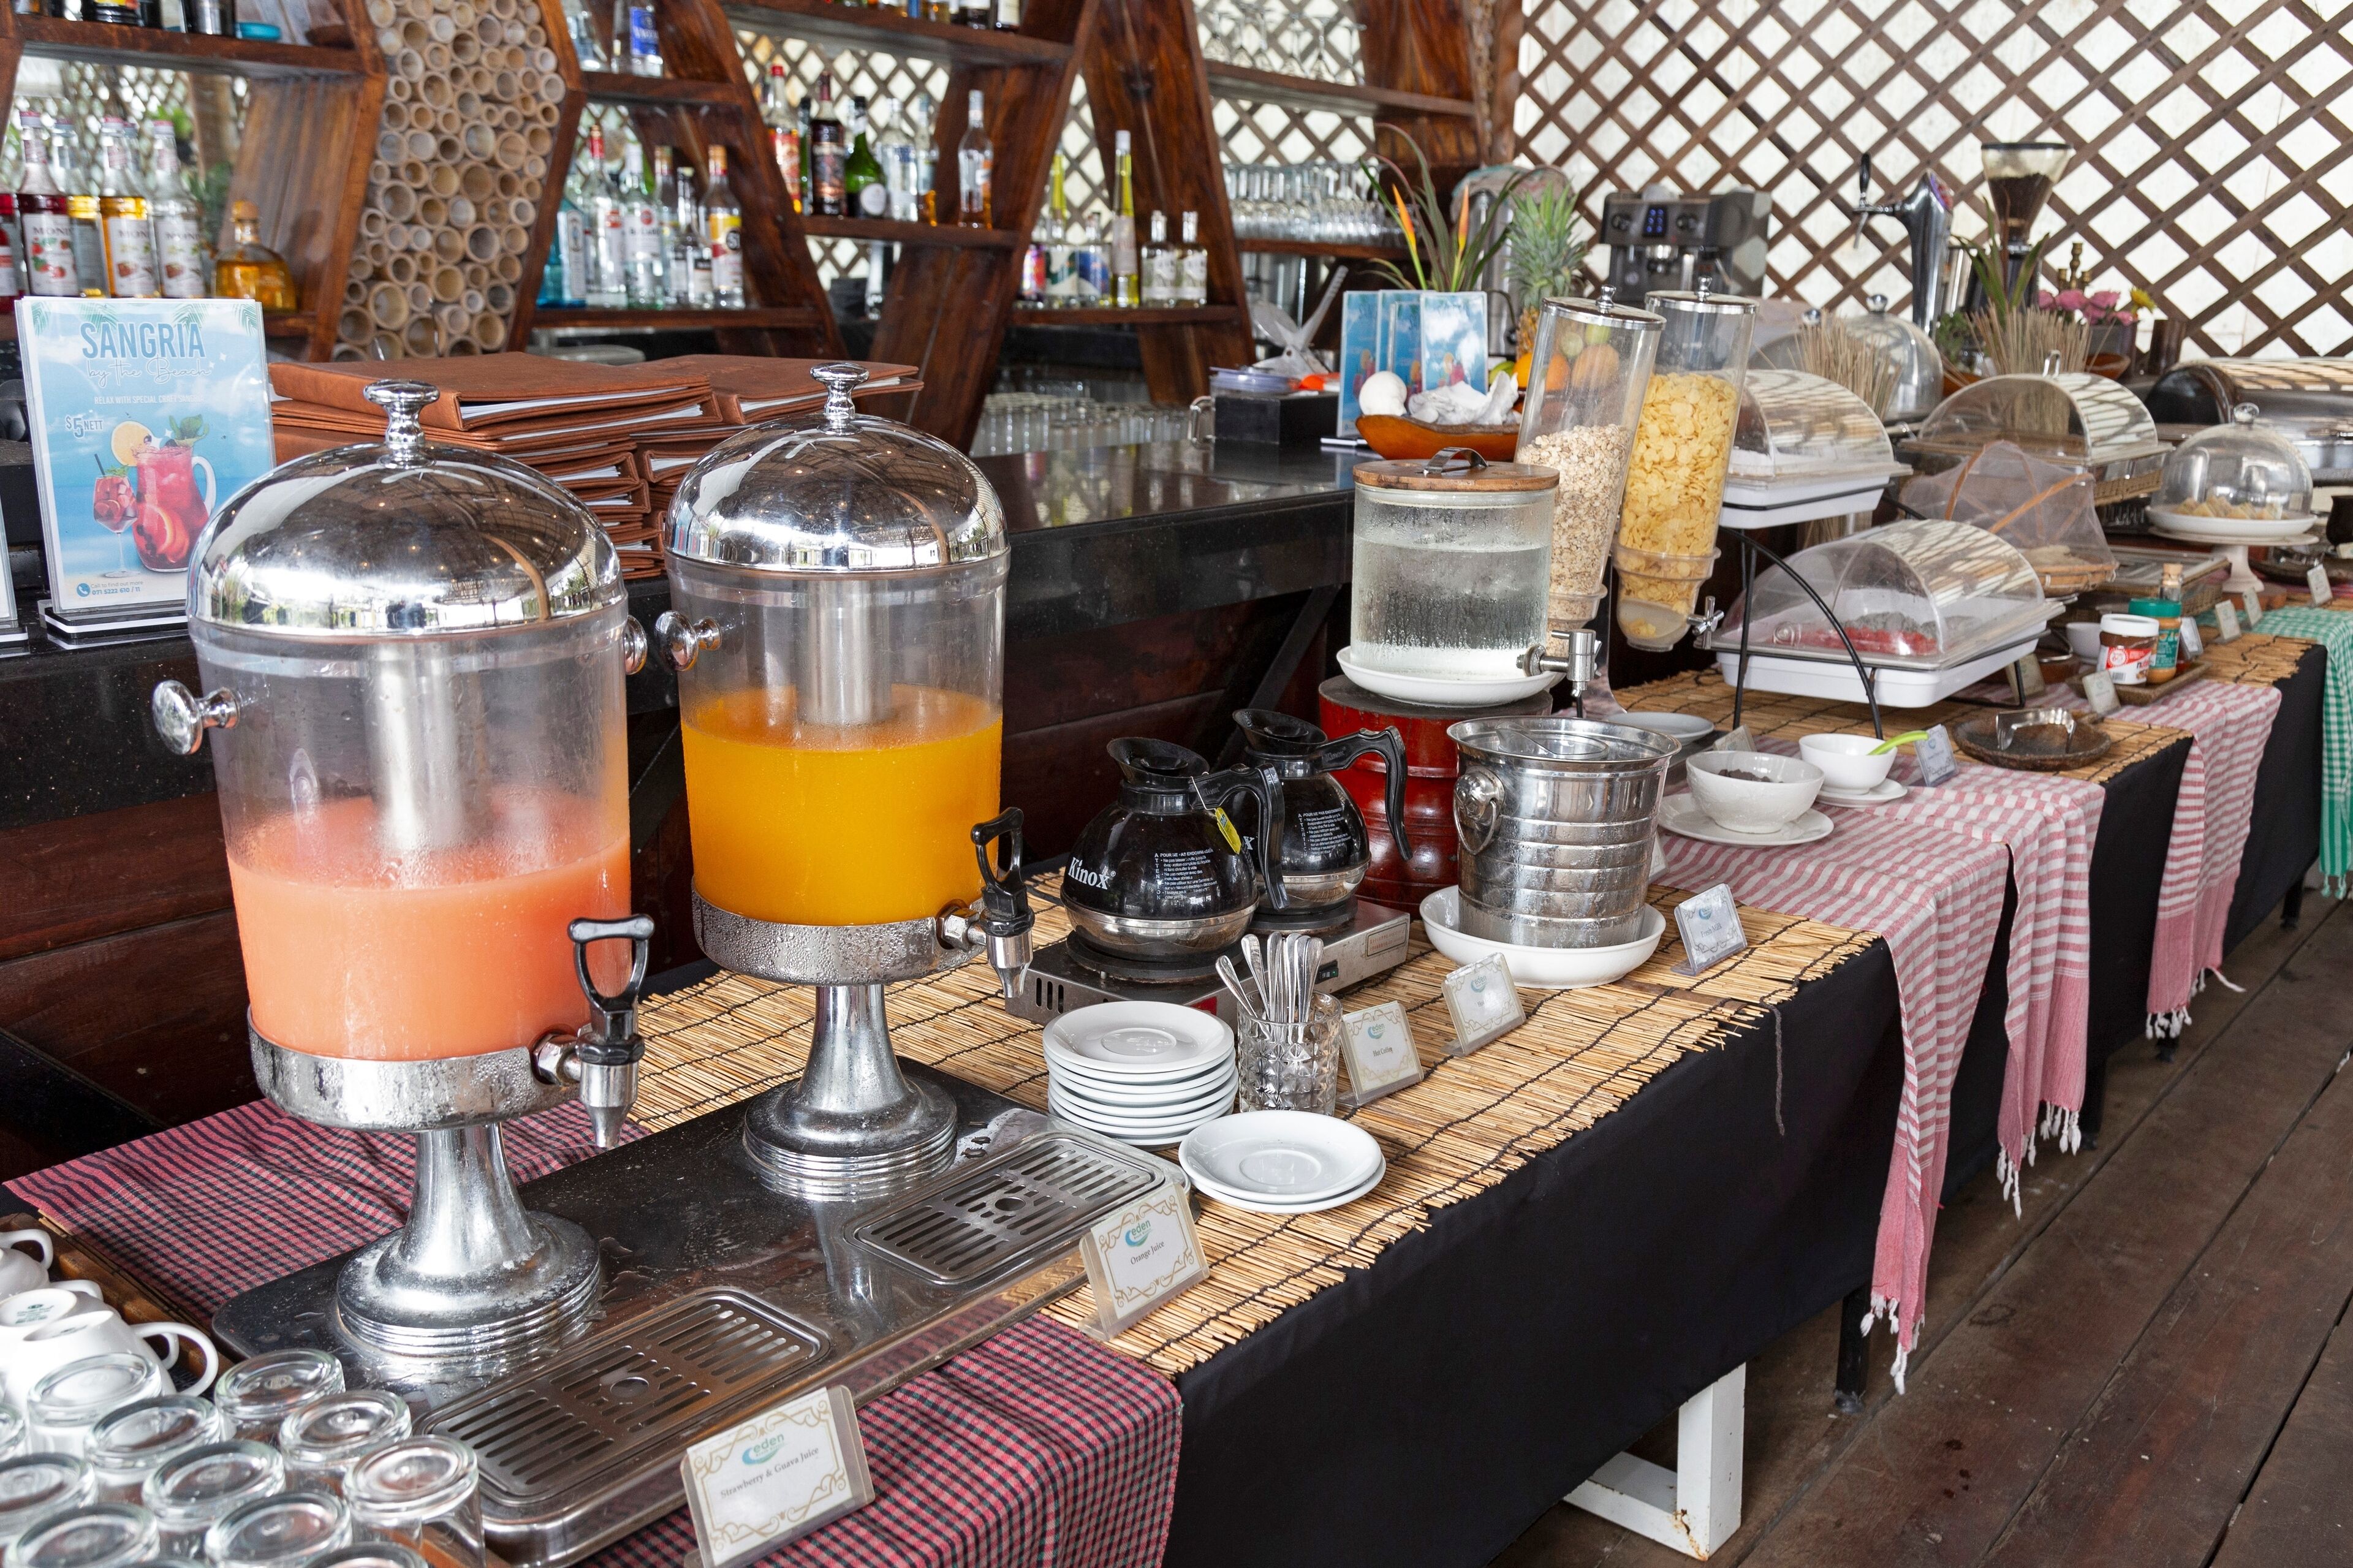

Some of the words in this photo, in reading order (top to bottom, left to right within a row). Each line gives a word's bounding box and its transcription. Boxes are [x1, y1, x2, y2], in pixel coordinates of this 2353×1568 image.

[80, 322, 206, 358] SANGRIA
[87, 360, 109, 387] by
[108, 359, 141, 385] the
[147, 355, 212, 384] Beach
[1700, 927, 1713, 937] Fresh
[1712, 922, 1722, 932] Milk
[1474, 975, 1487, 985] eden
[1131, 1220, 1151, 1235] eden
[1131, 1250, 1151, 1265] Orange
[1151, 1241, 1165, 1255] Juice
[753, 1434, 784, 1453] eden
[721, 1474, 763, 1498] Strawberry
[775, 1457, 799, 1472] Guava
[799, 1448, 819, 1463] Juice
